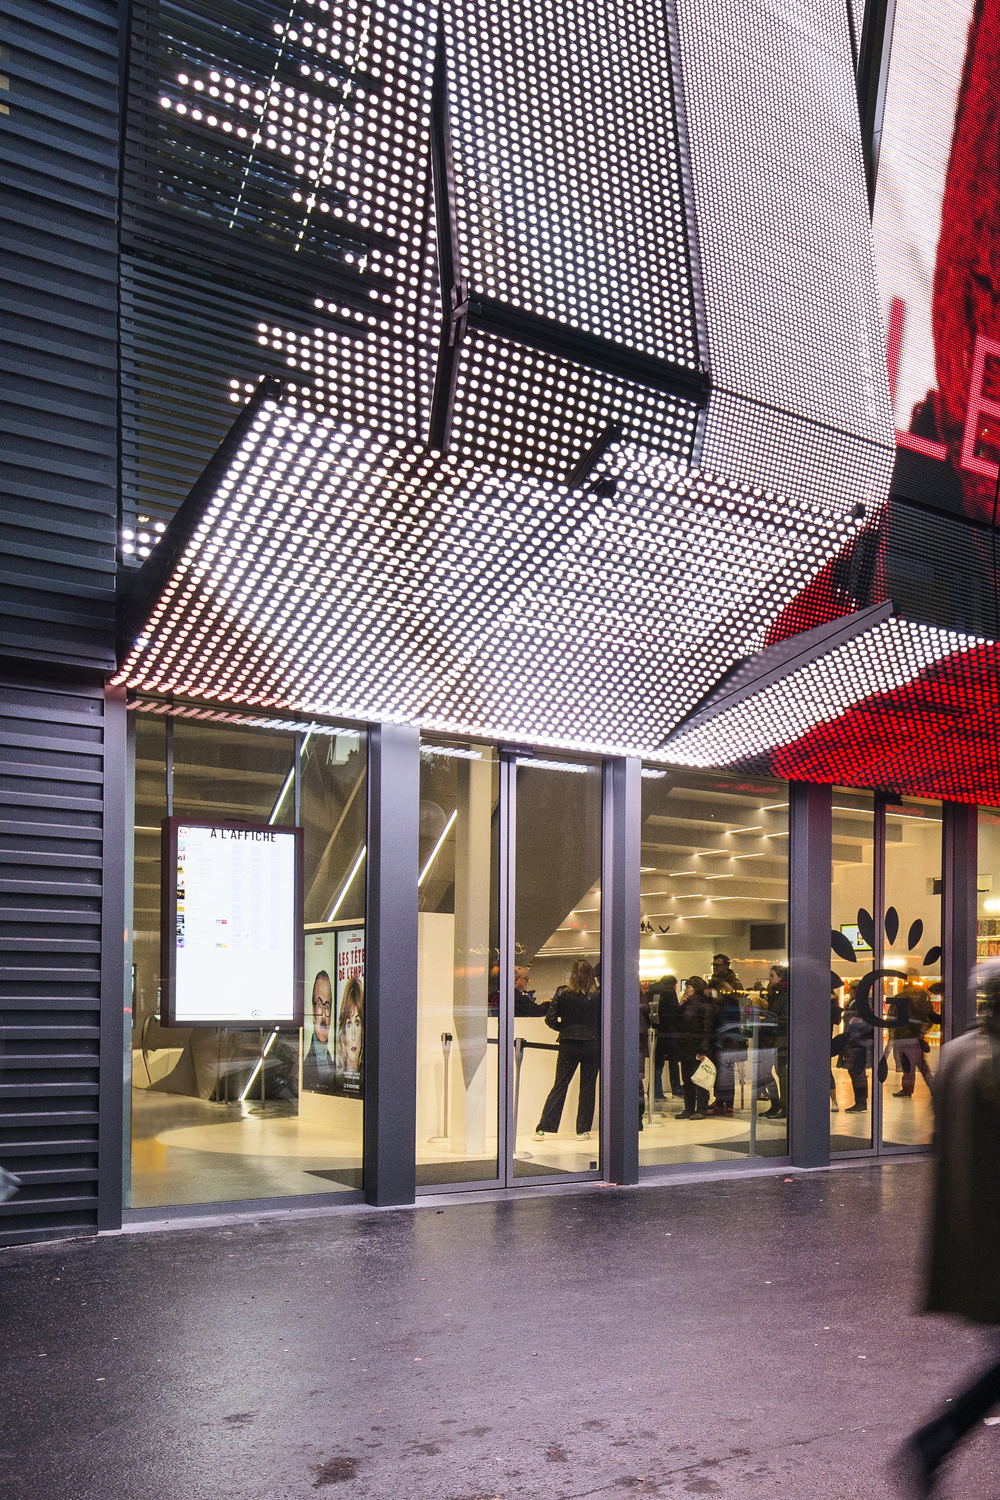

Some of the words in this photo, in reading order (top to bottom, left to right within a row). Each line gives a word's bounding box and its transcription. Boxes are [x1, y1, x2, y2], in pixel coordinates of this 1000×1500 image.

[221, 829, 277, 843] L'AFFICHE
[338, 951, 349, 967] LES
[338, 967, 345, 981] DE
[855, 968, 910, 1029] G
